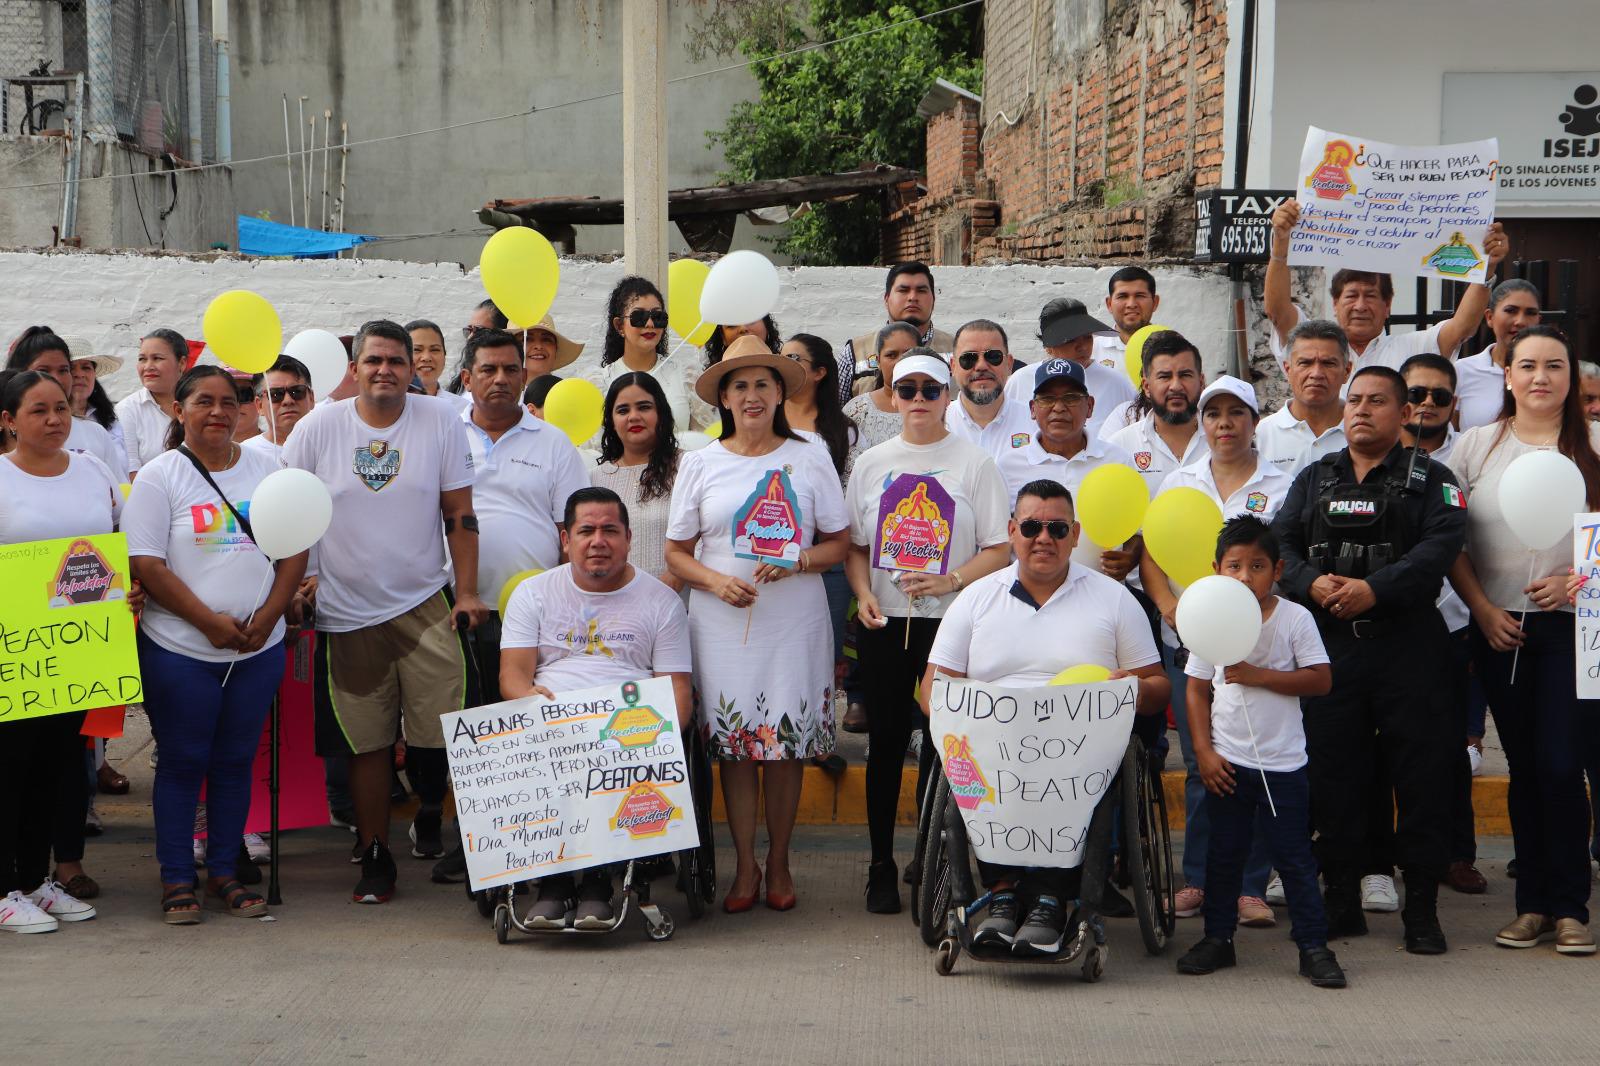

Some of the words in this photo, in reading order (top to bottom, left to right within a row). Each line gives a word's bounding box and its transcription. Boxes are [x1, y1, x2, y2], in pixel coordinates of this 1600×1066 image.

[1543, 138, 1600, 158] ISEJ
[1400, 159, 1441, 170] HACER
[1447, 154, 1481, 169] PARA
[1516, 165, 1589, 175] SINALOENSE
[1372, 171, 1395, 183] SER
[1399, 173, 1415, 182] UN
[1419, 173, 1446, 182] BUEN
[1500, 179, 1515, 188] DE
[1518, 178, 1541, 188] LOS
[1544, 176, 1597, 188] JÓVENES
[1408, 191, 1461, 206] siempre
[1465, 190, 1489, 205] por
[1419, 203, 1481, 216] peatones
[1328, 500, 1376, 513] POLICIA
[882, 541, 902, 558] soy
[903, 541, 943, 560] Peatón
[56, 571, 116, 597] Velocidad
[607, 631, 636, 642] JEANS
[1034, 698, 1054, 718] MI
[1063, 684, 1136, 723] VIDA
[452, 712, 535, 745] ALGUNAS
[540, 699, 616, 722] PERSONAS
[450, 742, 500, 760] VAMOS
[502, 738, 520, 750] EN
[525, 727, 565, 745] SILLAS
[571, 721, 589, 736] DE
[505, 751, 546, 766] OTRAS
[549, 740, 605, 759] APOYADAS
[454, 779, 472, 791] EN
[550, 757, 586, 781] PERO
[587, 754, 609, 769] NO
[612, 747, 640, 764] POR
[644, 743, 675, 758] ELLO
[458, 789, 531, 816] DEJAMOS
[535, 786, 554, 801] DE
[557, 780, 584, 798] SER
[585, 760, 686, 800] PEATONES
[492, 815, 505, 830] 17
[509, 803, 560, 830] agosto
[616, 806, 676, 829] Velocidad
[511, 820, 565, 848] Mundial
[569, 816, 590, 836] del
